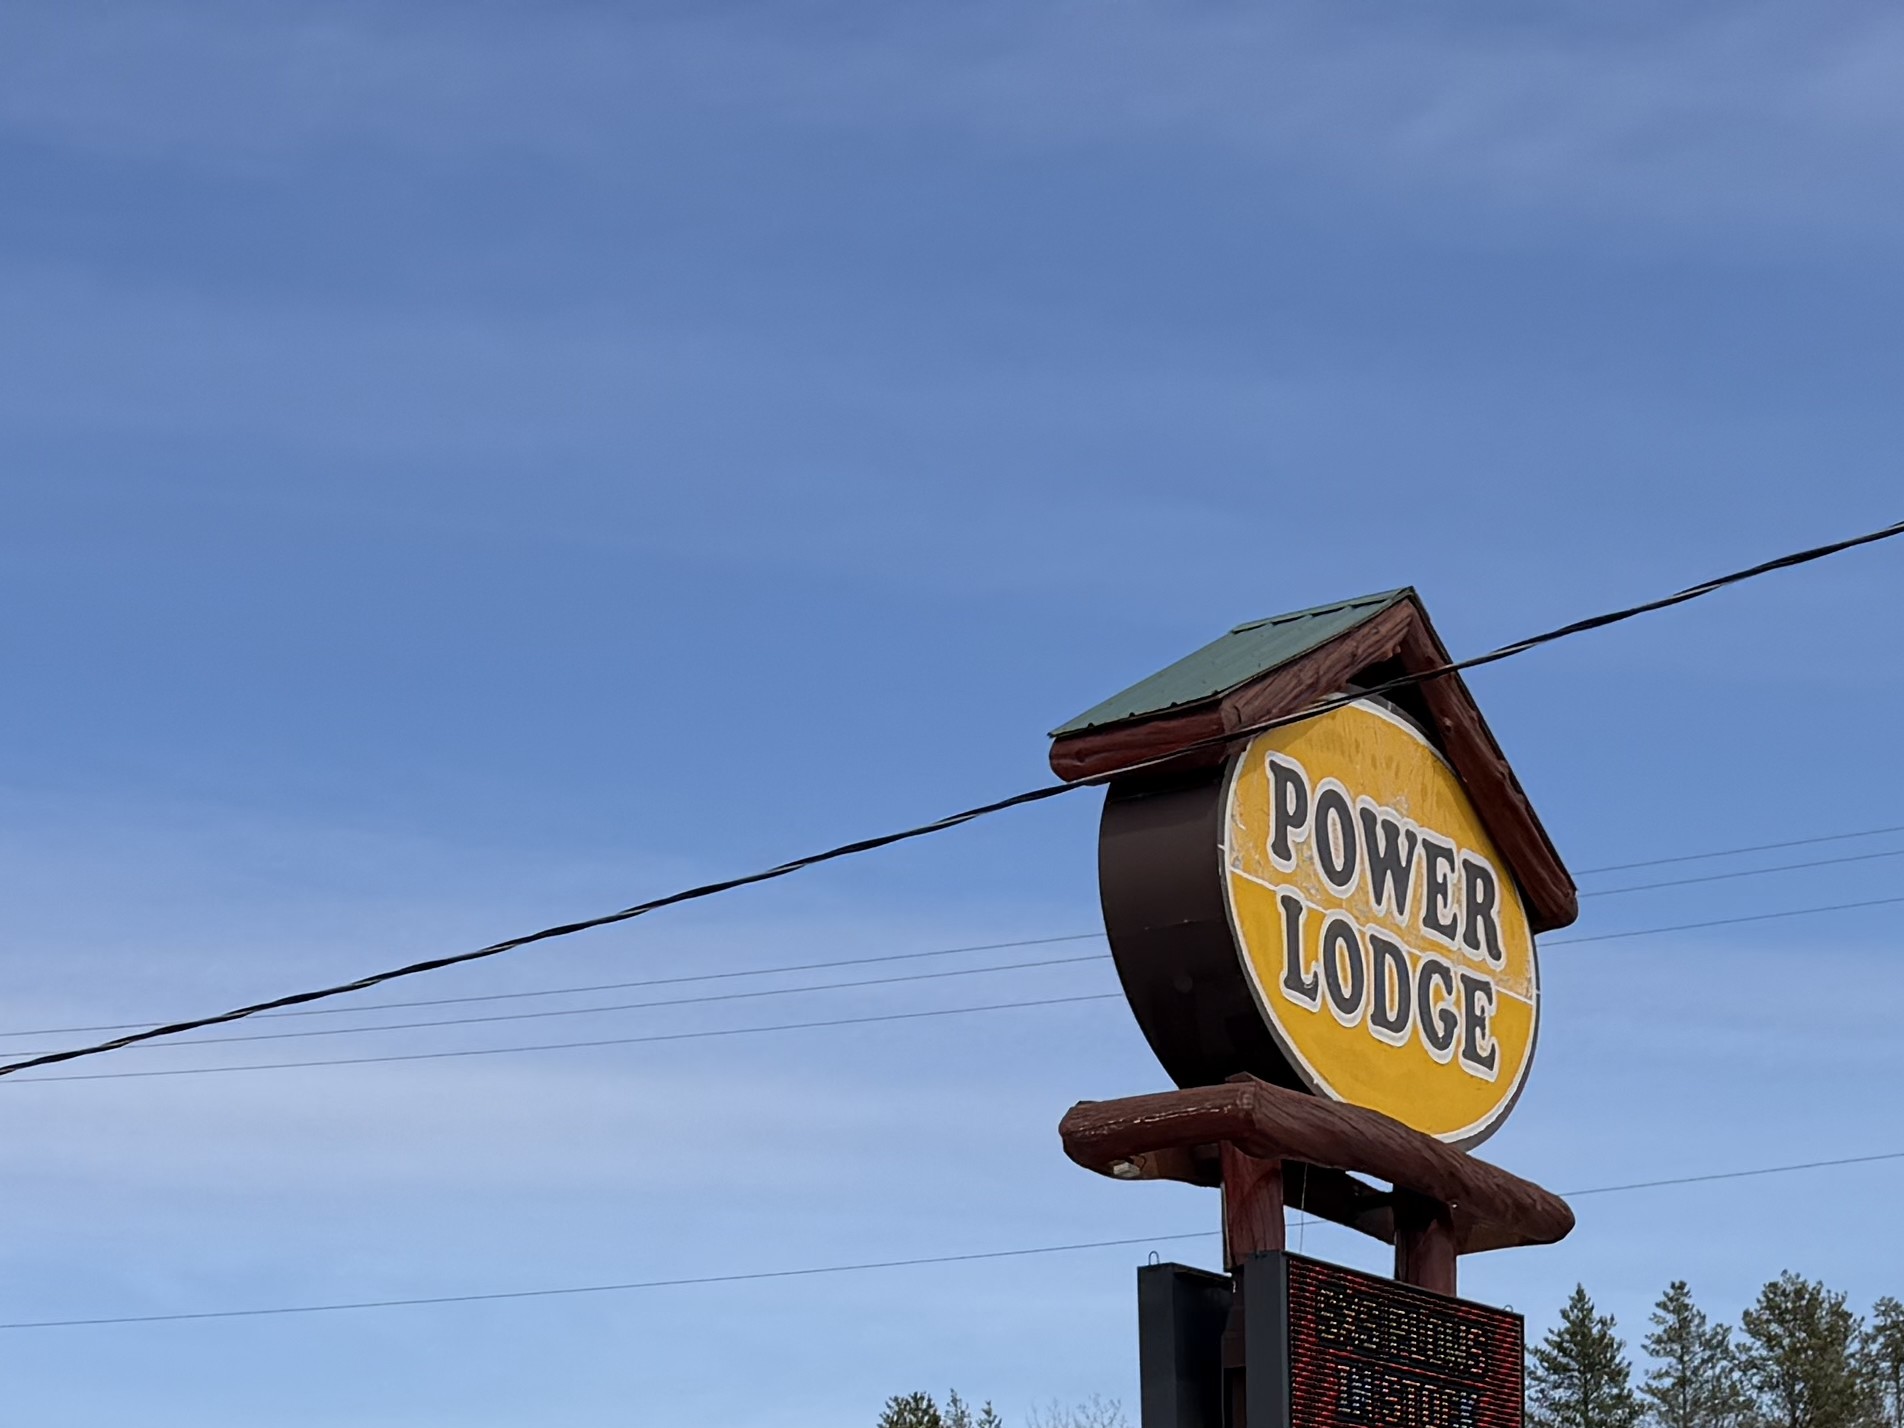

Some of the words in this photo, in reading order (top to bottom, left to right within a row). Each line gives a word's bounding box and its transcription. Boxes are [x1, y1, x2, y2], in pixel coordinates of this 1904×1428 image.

[1267, 756, 1503, 965] POWER
[1276, 891, 1500, 1077] LODGE
[1337, 1364, 1373, 1418] IN
